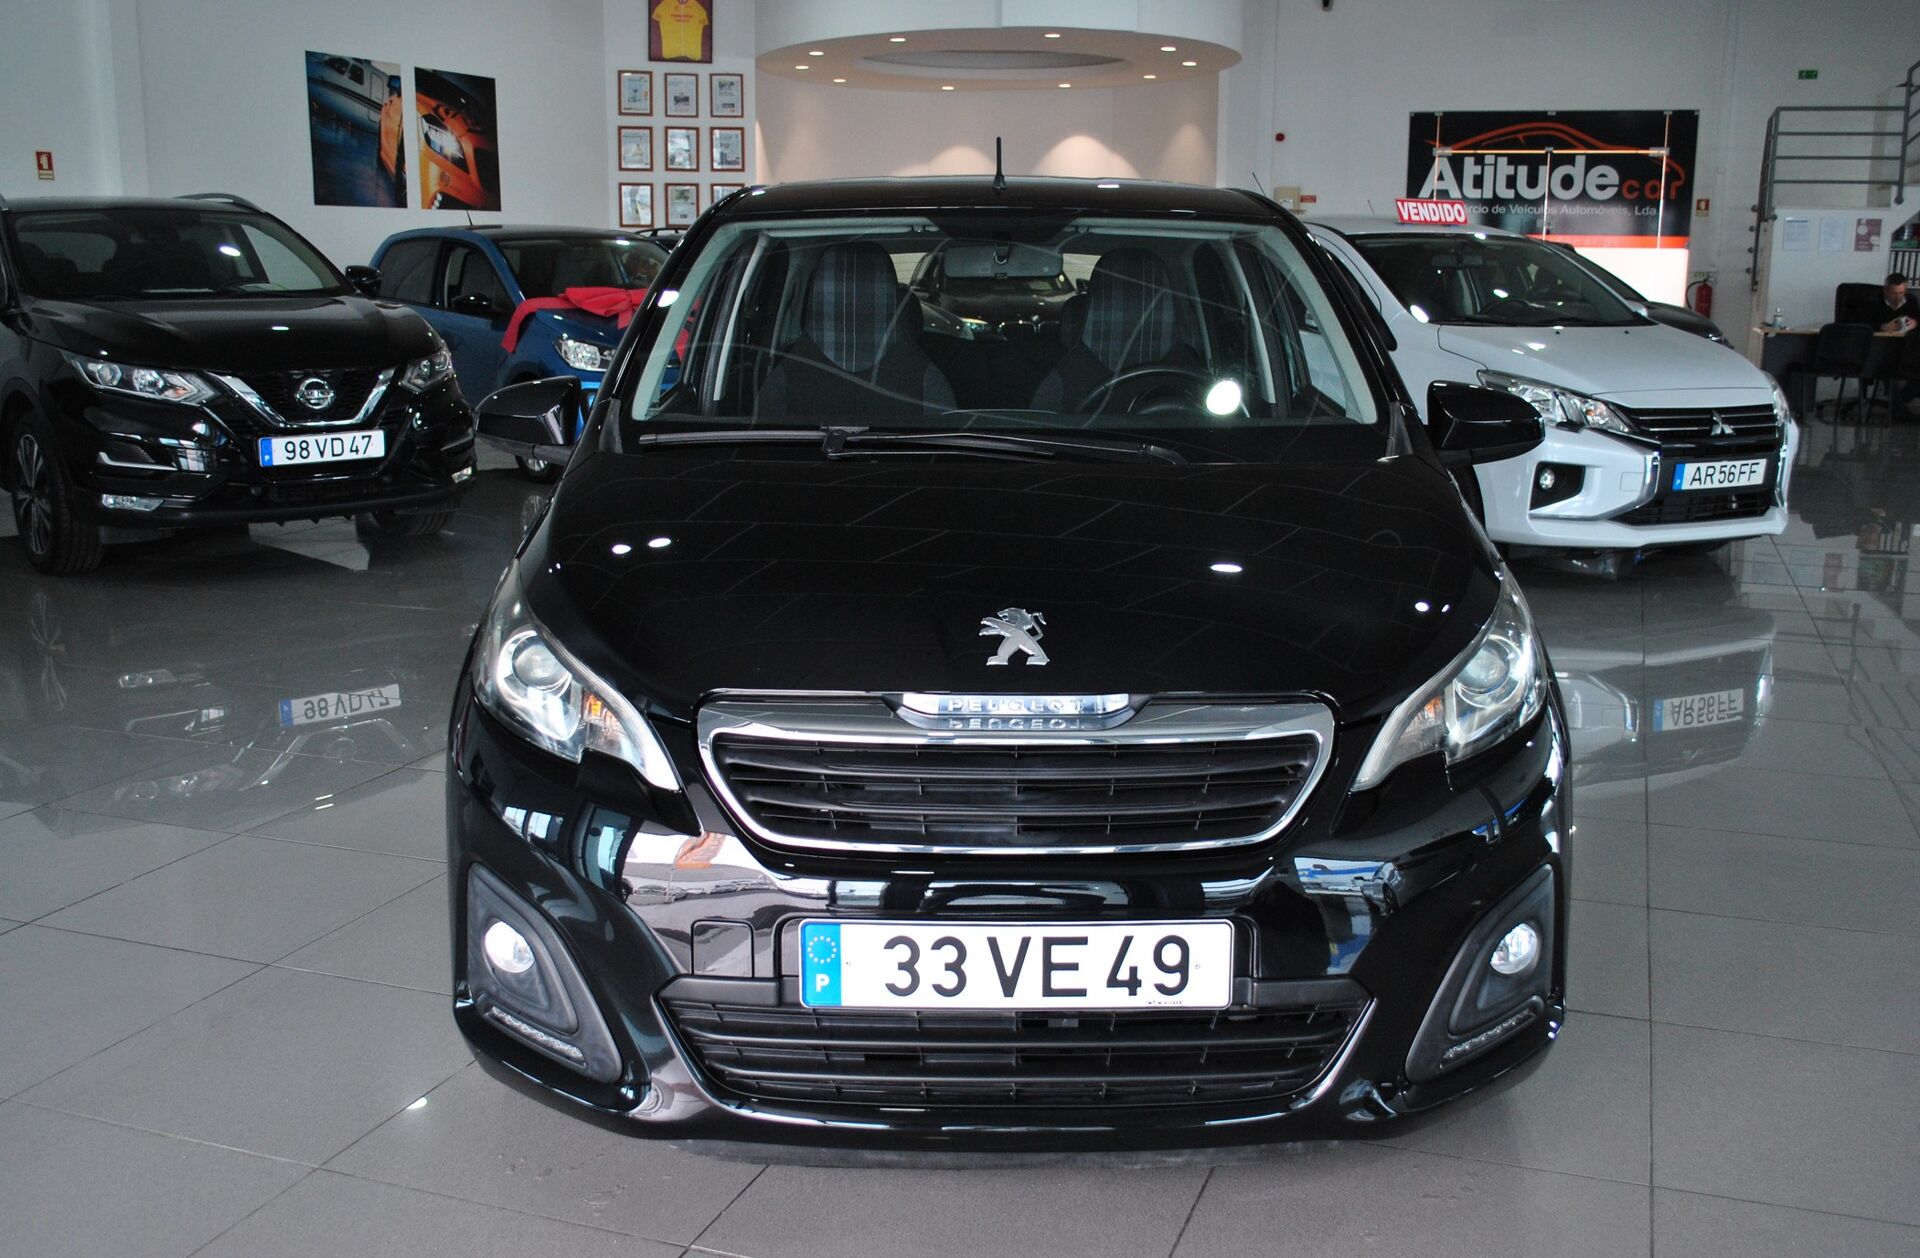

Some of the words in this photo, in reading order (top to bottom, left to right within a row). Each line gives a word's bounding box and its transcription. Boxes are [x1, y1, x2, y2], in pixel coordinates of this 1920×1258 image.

[1418, 155, 1620, 200] Atitude
[1397, 201, 1466, 222] VENDIDO
[1491, 203, 1506, 214] de
[815, 974, 830, 992] P
